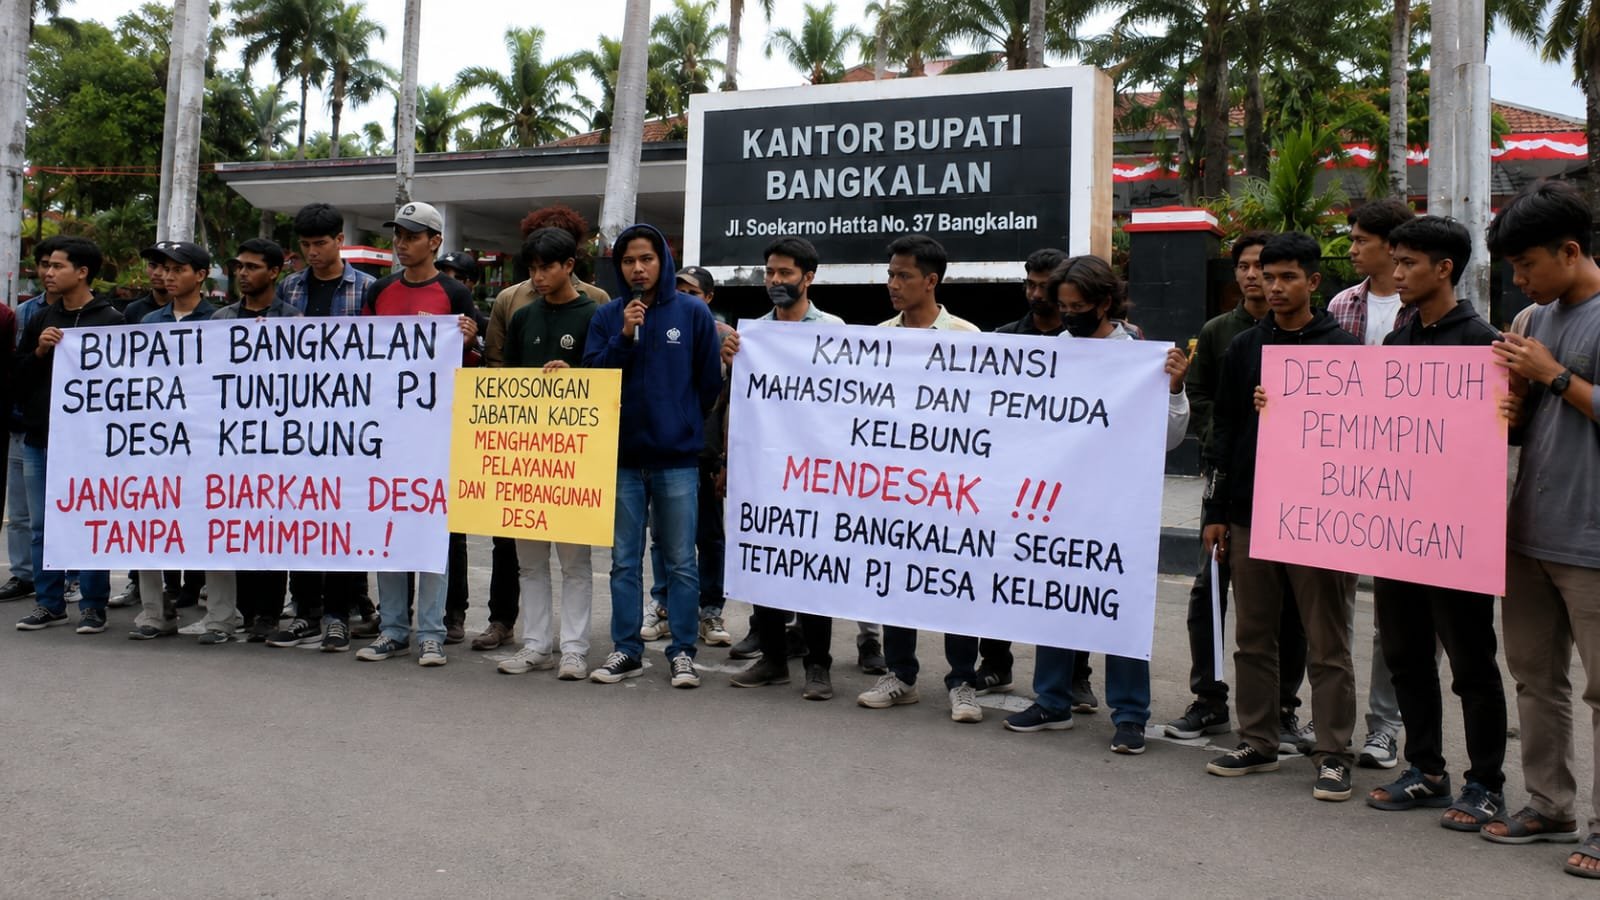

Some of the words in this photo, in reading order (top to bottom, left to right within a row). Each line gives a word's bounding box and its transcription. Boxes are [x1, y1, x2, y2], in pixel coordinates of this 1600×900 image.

[743, 121, 884, 159] KANTOR
[894, 113, 1022, 152] BUPATI
[766, 161, 992, 200] BANGKALAN
[726, 218, 744, 237] Jl.
[746, 218, 826, 236] Soekarno
[829, 215, 878, 234] Hatta
[881, 215, 909, 233] No.
[913, 213, 933, 232] 37
[938, 211, 1038, 235] Bangkalan
[80, 324, 203, 370] BUPATI
[230, 322, 437, 364] BANGKALAN
[812, 334, 892, 368] KAMI
[925, 342, 1057, 379] ALIANSI
[62, 375, 187, 414] SEGERA
[397, 370, 437, 410] PJ
[475, 376, 590, 400] KEKOSONGAN
[1282, 358, 1364, 397] DESA
[1384, 360, 1485, 400] BUTUH
[469, 404, 538, 425] JABATAN
[548, 406, 599, 427] KADES
[746, 373, 895, 409] MAHASISWA
[916, 385, 970, 414] DAN
[989, 390, 1109, 428] PEMUDA
[106, 421, 191, 457] DESA
[219, 418, 383, 459] KELBUNG
[475, 430, 588, 454] MENGHAMBAT
[851, 418, 992, 458] KELBUNG
[1302, 410, 1444, 455] PEMIMPIN
[482, 455, 575, 479] PELAYANAN
[1320, 462, 1412, 502] BUKAN
[56, 474, 182, 513] JANGAN
[206, 473, 341, 511] BIARKAN
[368, 476, 448, 515] DESA
[458, 479, 485, 500] DAN
[496, 482, 602, 508] PEMBANGUNAN
[782, 455, 982, 516] MENDESAK
[1011, 478, 1063, 524] !!!
[84, 519, 185, 554] TANPA
[502, 508, 548, 530] DESA
[740, 502, 818, 539] BUPATI
[834, 512, 996, 558] BANGKALAN
[1014, 532, 1124, 575] SEGERA
[1278, 502, 1464, 560] KEKOSONGAN
[739, 542, 850, 584] TETAPKAN
[906, 563, 975, 602] DESA
[992, 572, 1120, 620] KELBUNG
